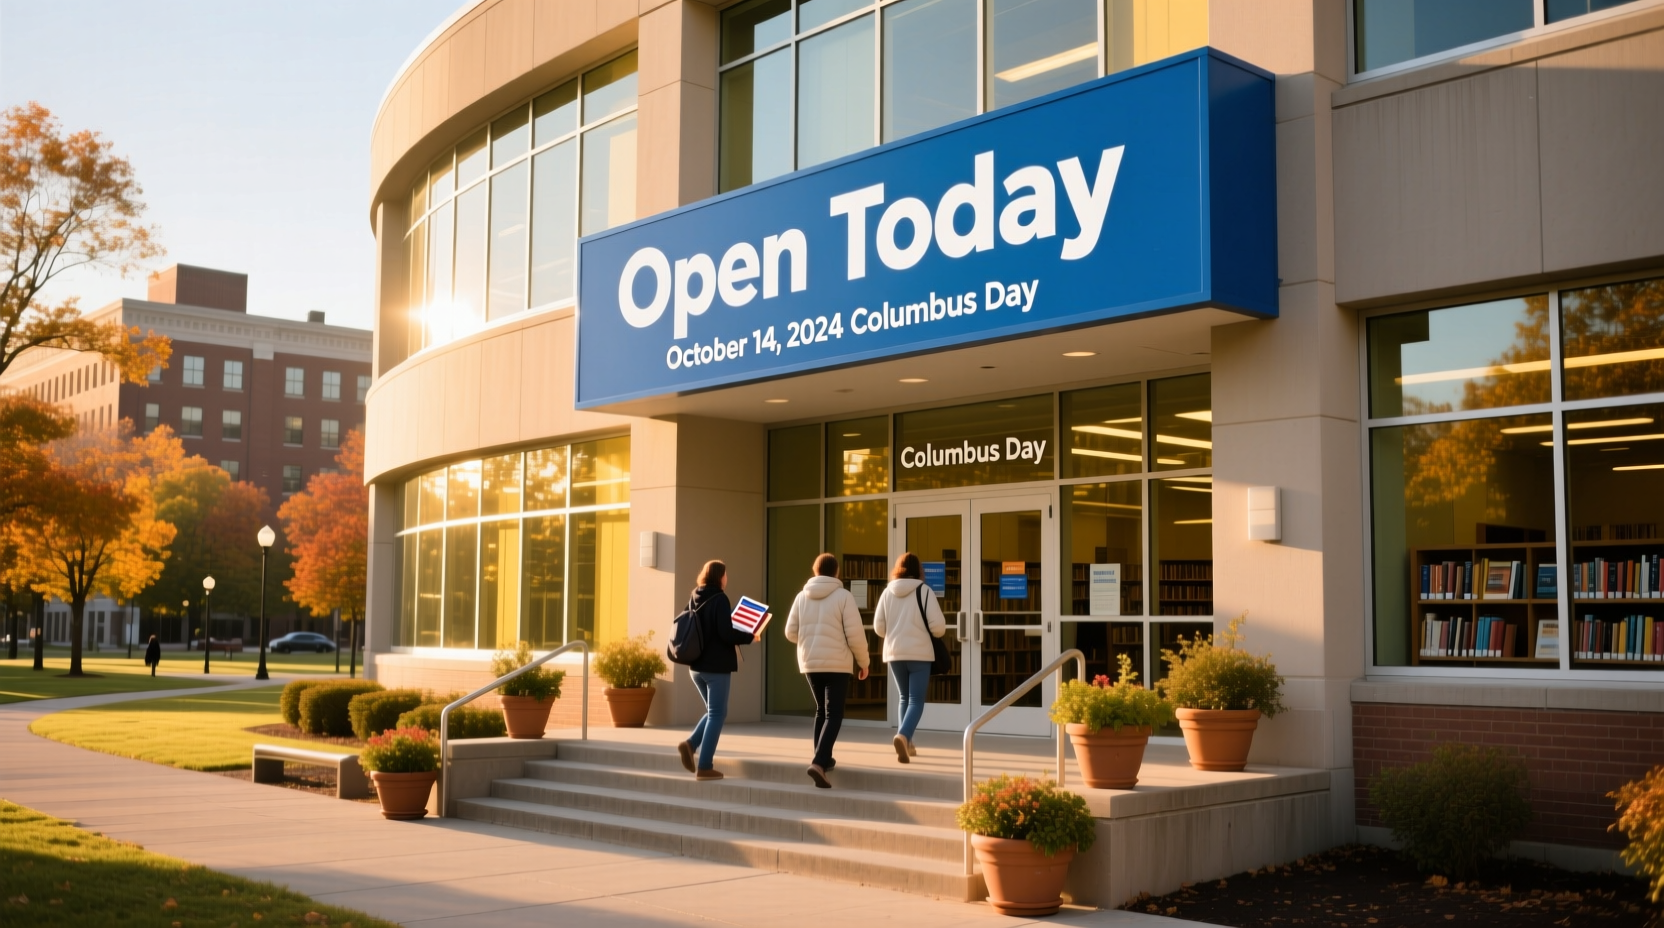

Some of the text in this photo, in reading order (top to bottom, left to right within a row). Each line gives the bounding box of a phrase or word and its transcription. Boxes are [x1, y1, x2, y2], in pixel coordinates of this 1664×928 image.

[617, 144, 1125, 340] Open Today
[666, 279, 1039, 370] October 14, 2024 Columbus Day
[900, 437, 1047, 469] Columbus Day
